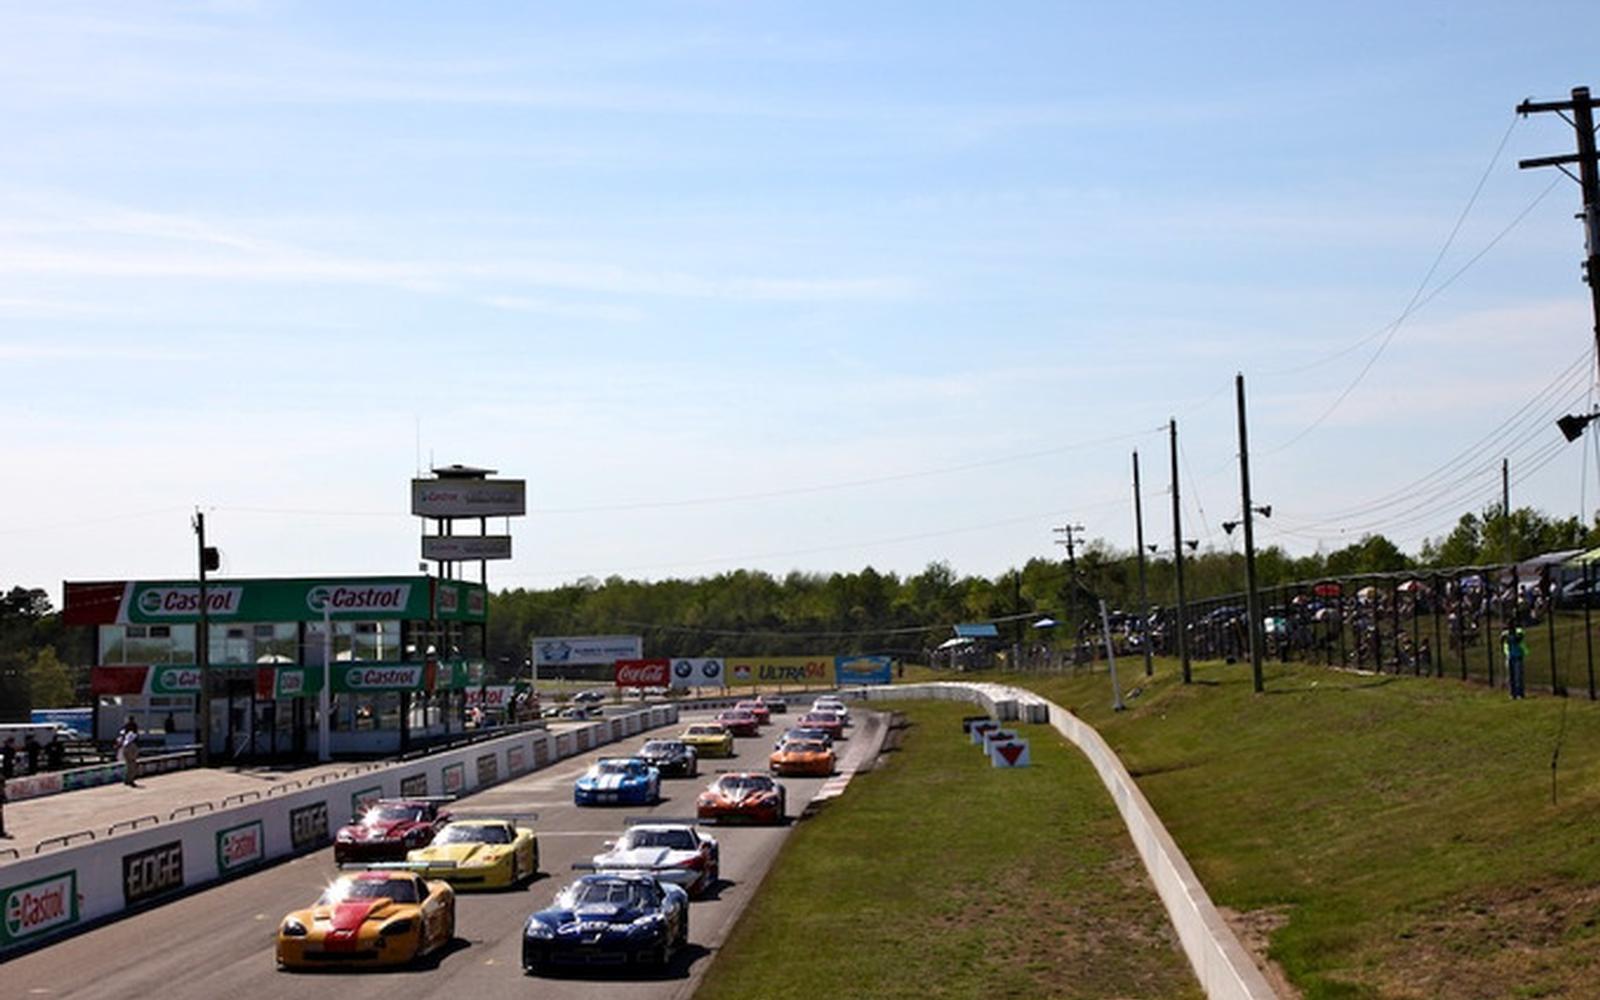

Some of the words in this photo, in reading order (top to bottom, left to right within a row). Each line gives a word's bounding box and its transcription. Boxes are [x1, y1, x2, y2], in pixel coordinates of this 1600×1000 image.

[164, 590, 233, 611] Casrol
[331, 586, 401, 608] Castrol
[363, 669, 416, 685] Castrol
[127, 847, 182, 897] EDGE
[22, 882, 65, 928] Castrol
